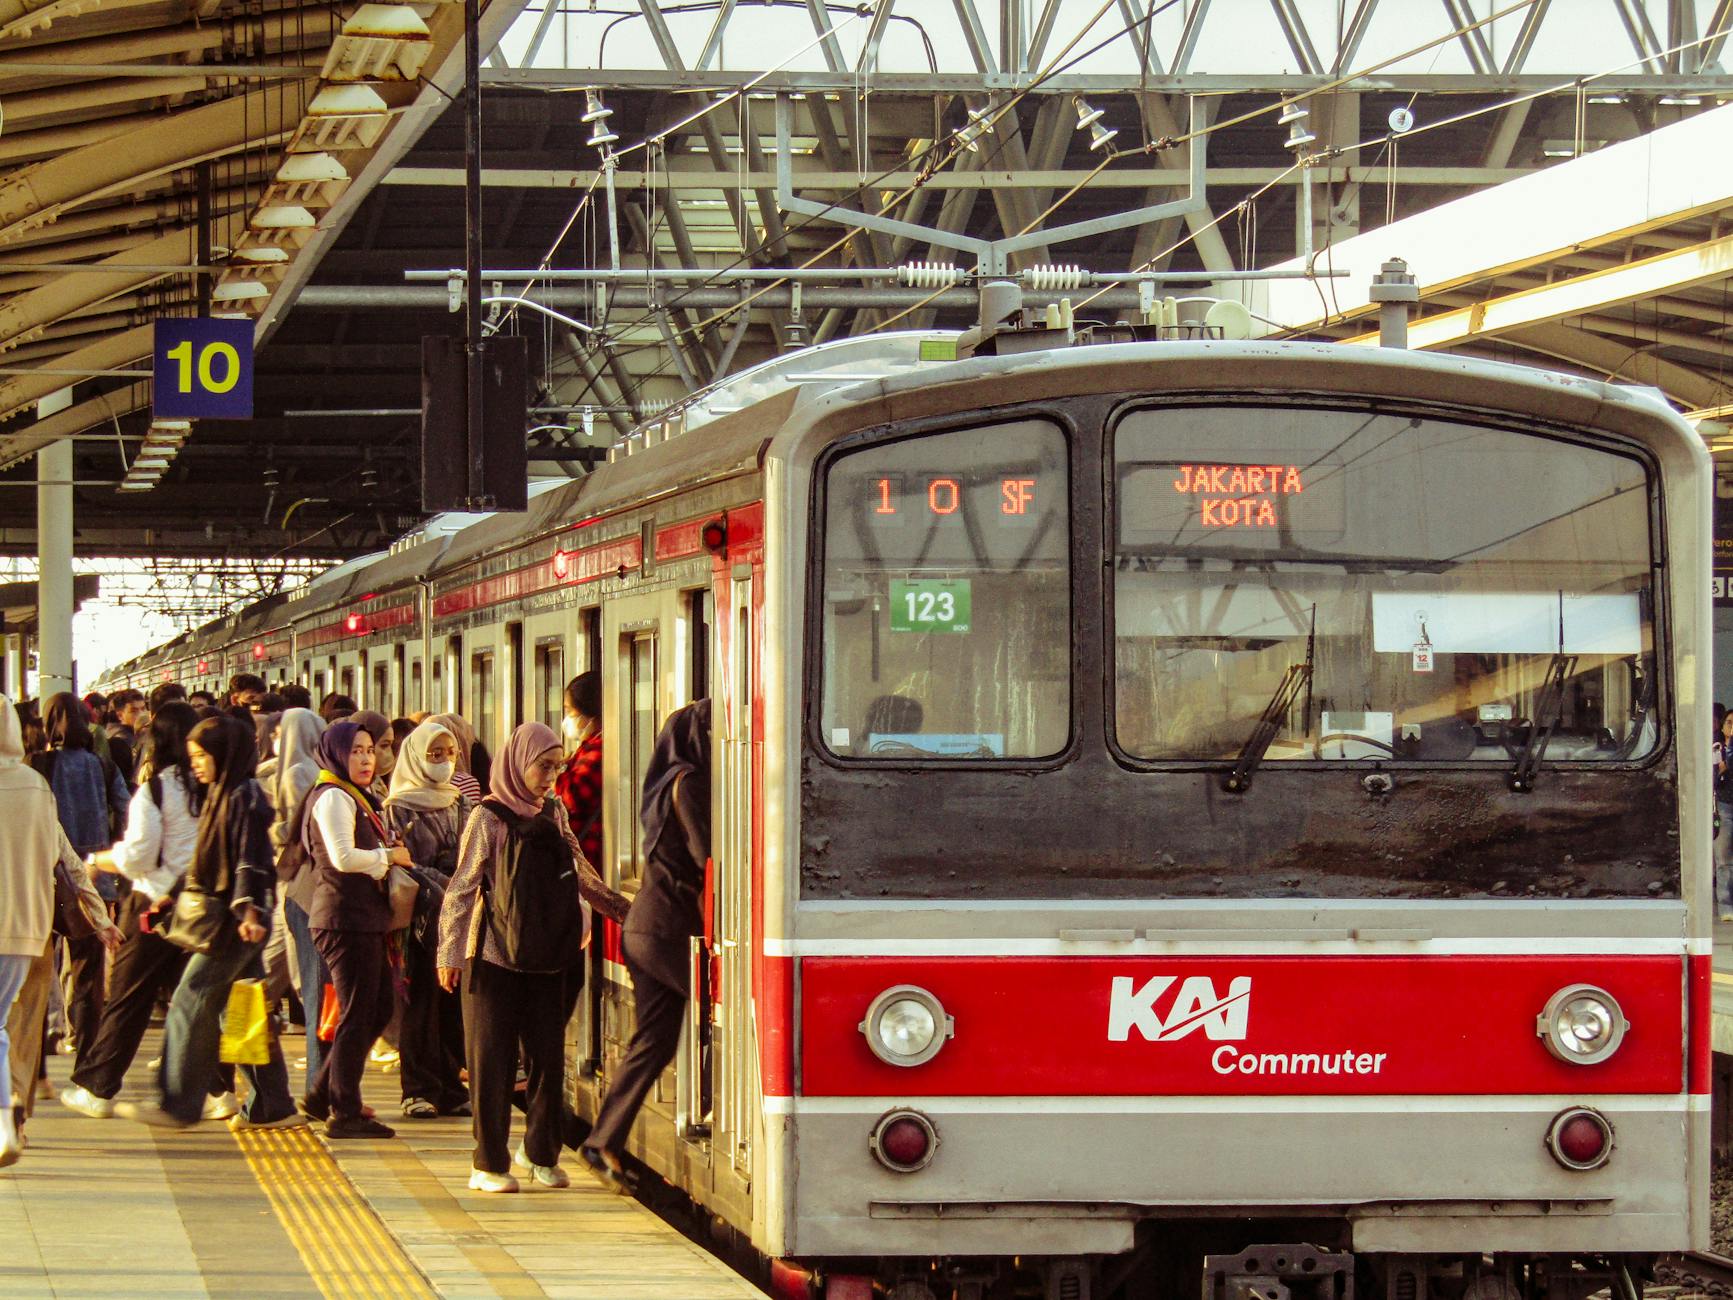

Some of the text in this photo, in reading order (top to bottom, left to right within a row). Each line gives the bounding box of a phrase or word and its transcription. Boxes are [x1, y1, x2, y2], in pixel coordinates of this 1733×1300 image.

[167, 341, 240, 394] 10
[1174, 466, 1303, 493] JAKARTA
[1001, 479, 1036, 514] SF
[1202, 499, 1277, 526] KOTA
[905, 592, 954, 622] 123
[1107, 976, 1252, 1041] KAI
[1212, 1045, 1387, 1075] Commuter
